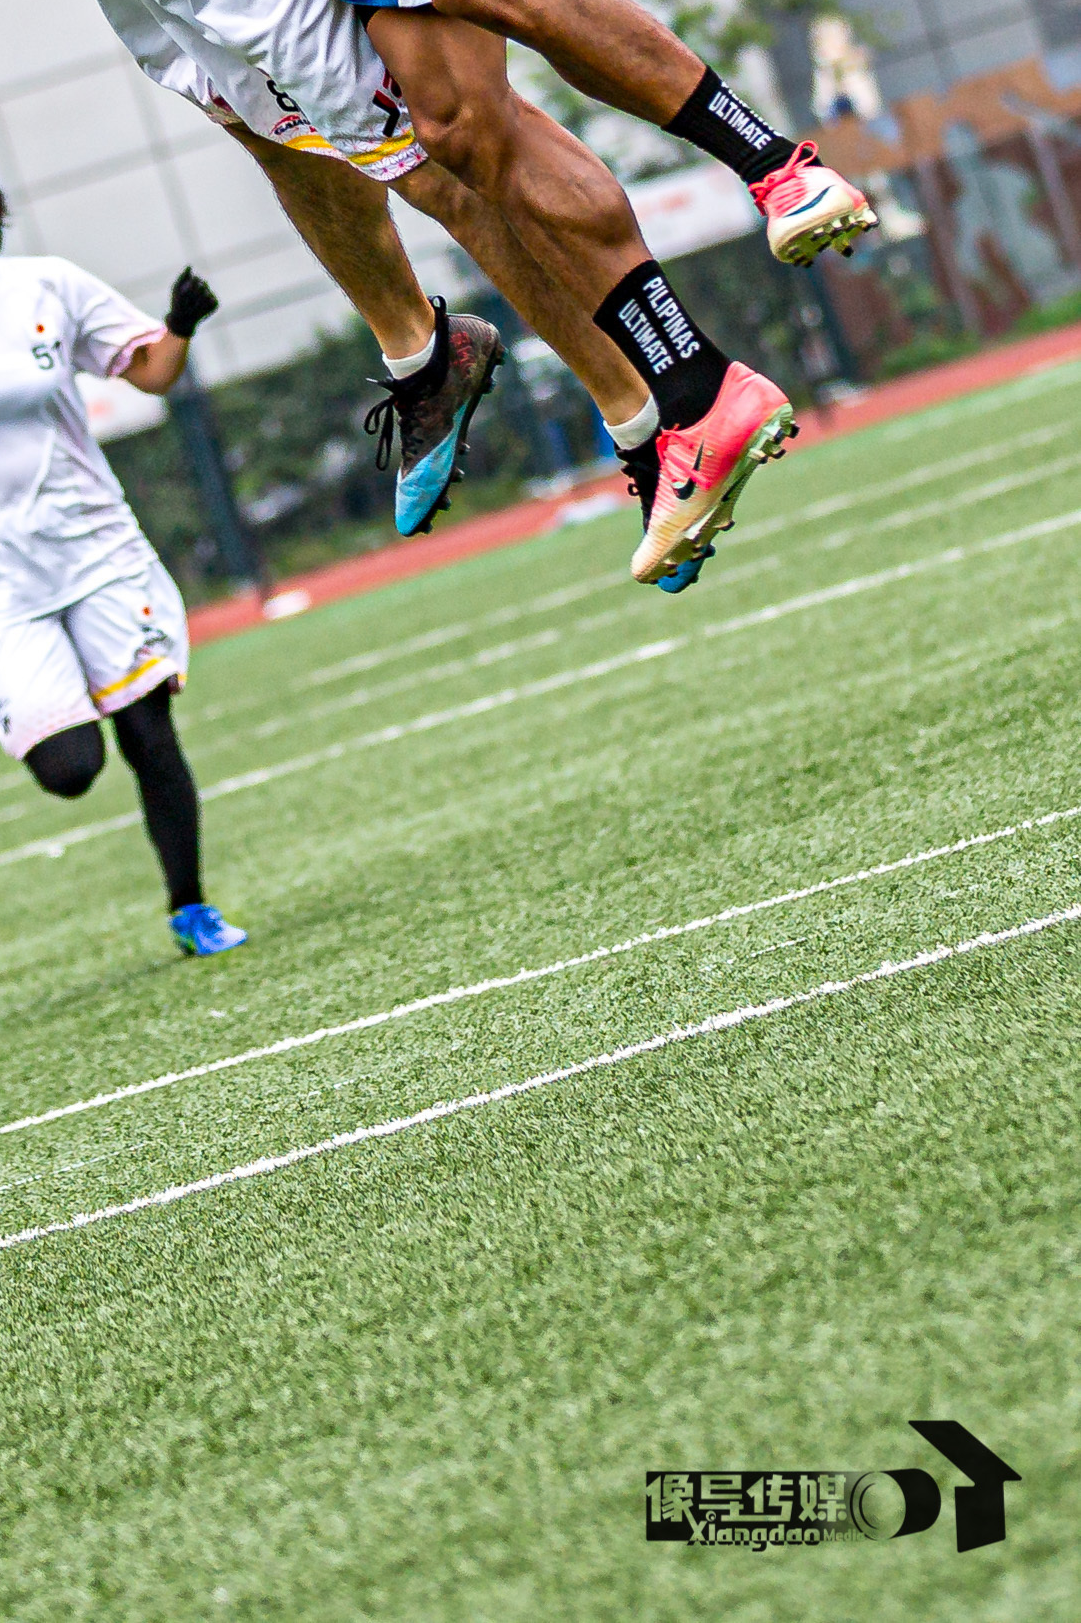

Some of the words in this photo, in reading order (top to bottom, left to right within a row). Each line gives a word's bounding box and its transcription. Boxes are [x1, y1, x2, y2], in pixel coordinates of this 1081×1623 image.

[708, 91, 773, 151] ULTIMATE
[618, 298, 675, 375] ULTIMATE
[642, 276, 701, 359] PILIPINAS
